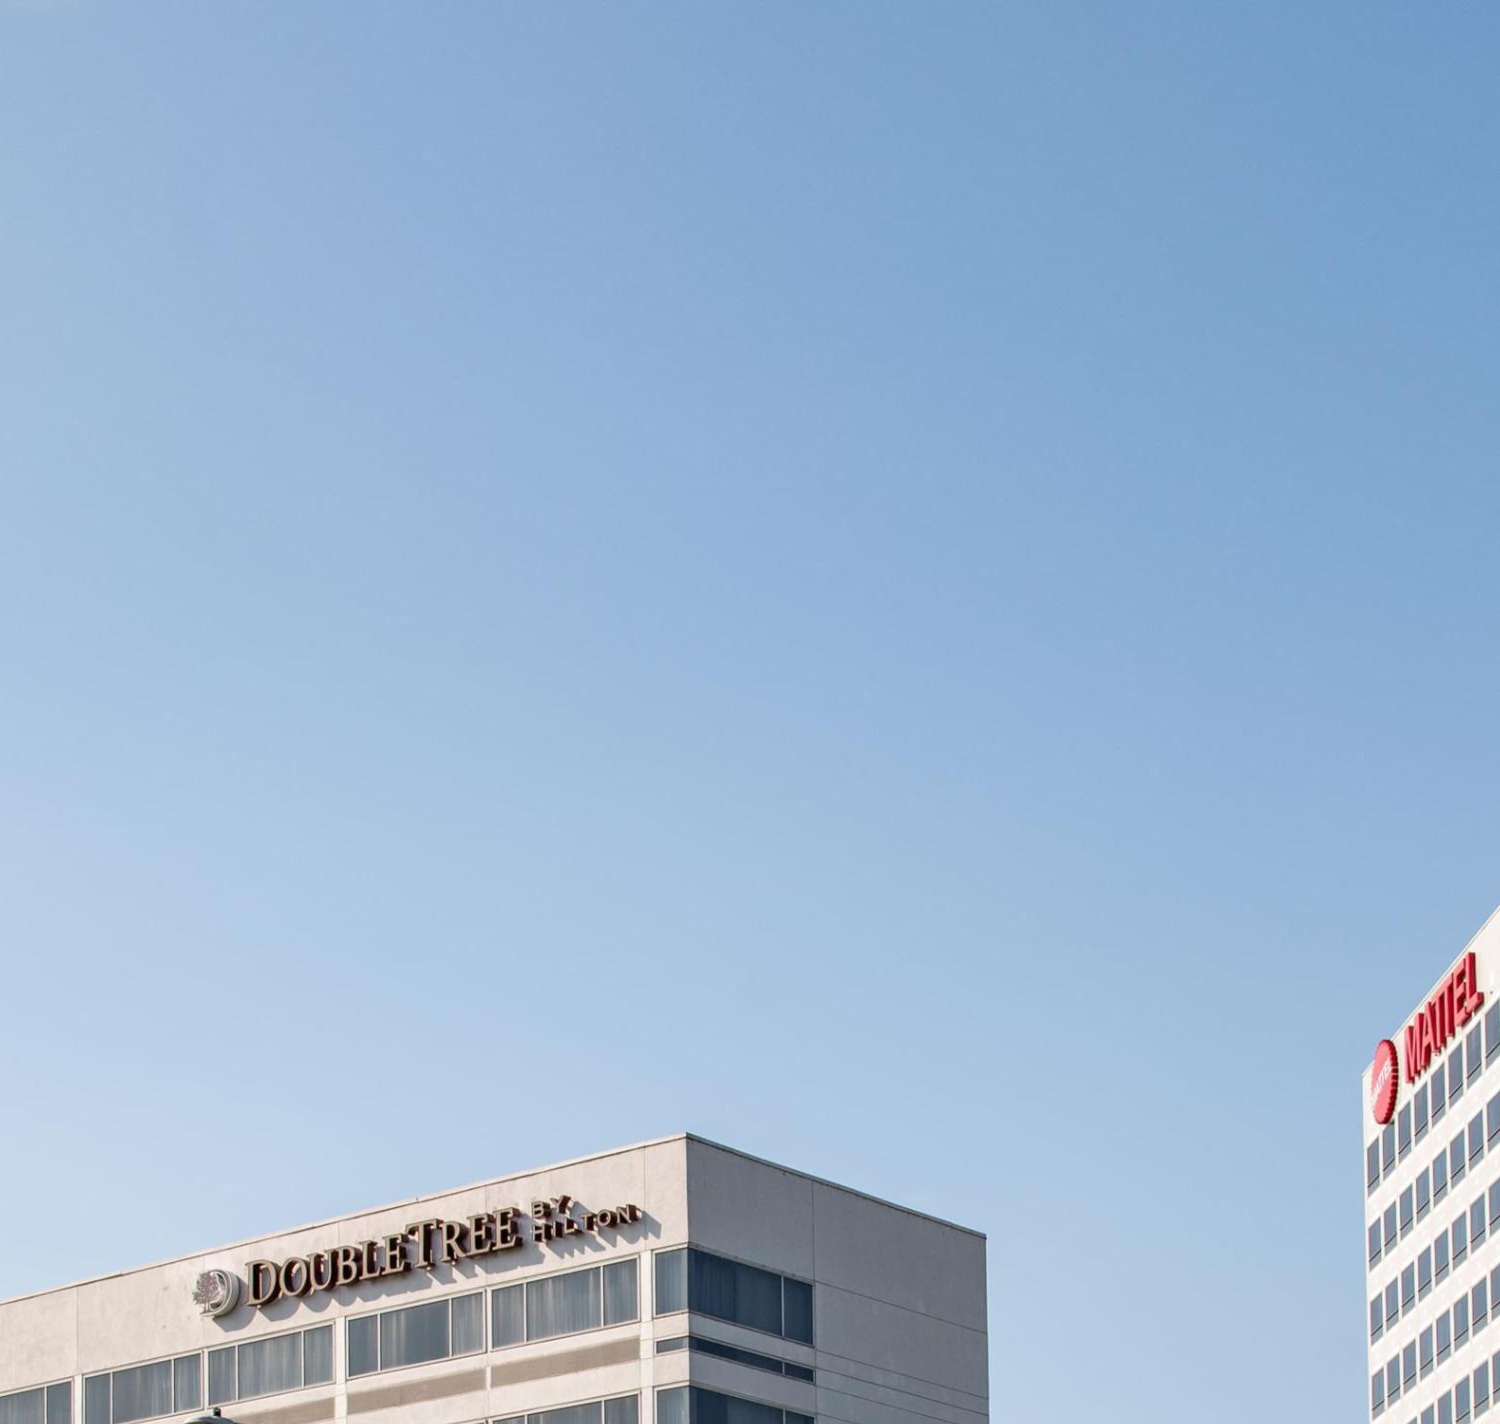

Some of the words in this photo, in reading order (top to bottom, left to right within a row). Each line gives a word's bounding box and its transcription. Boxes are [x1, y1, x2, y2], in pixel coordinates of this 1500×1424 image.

[1404, 952, 1485, 1084] MATTEL
[531, 1195, 573, 1219] BY
[531, 1203, 641, 1243] HILTON
